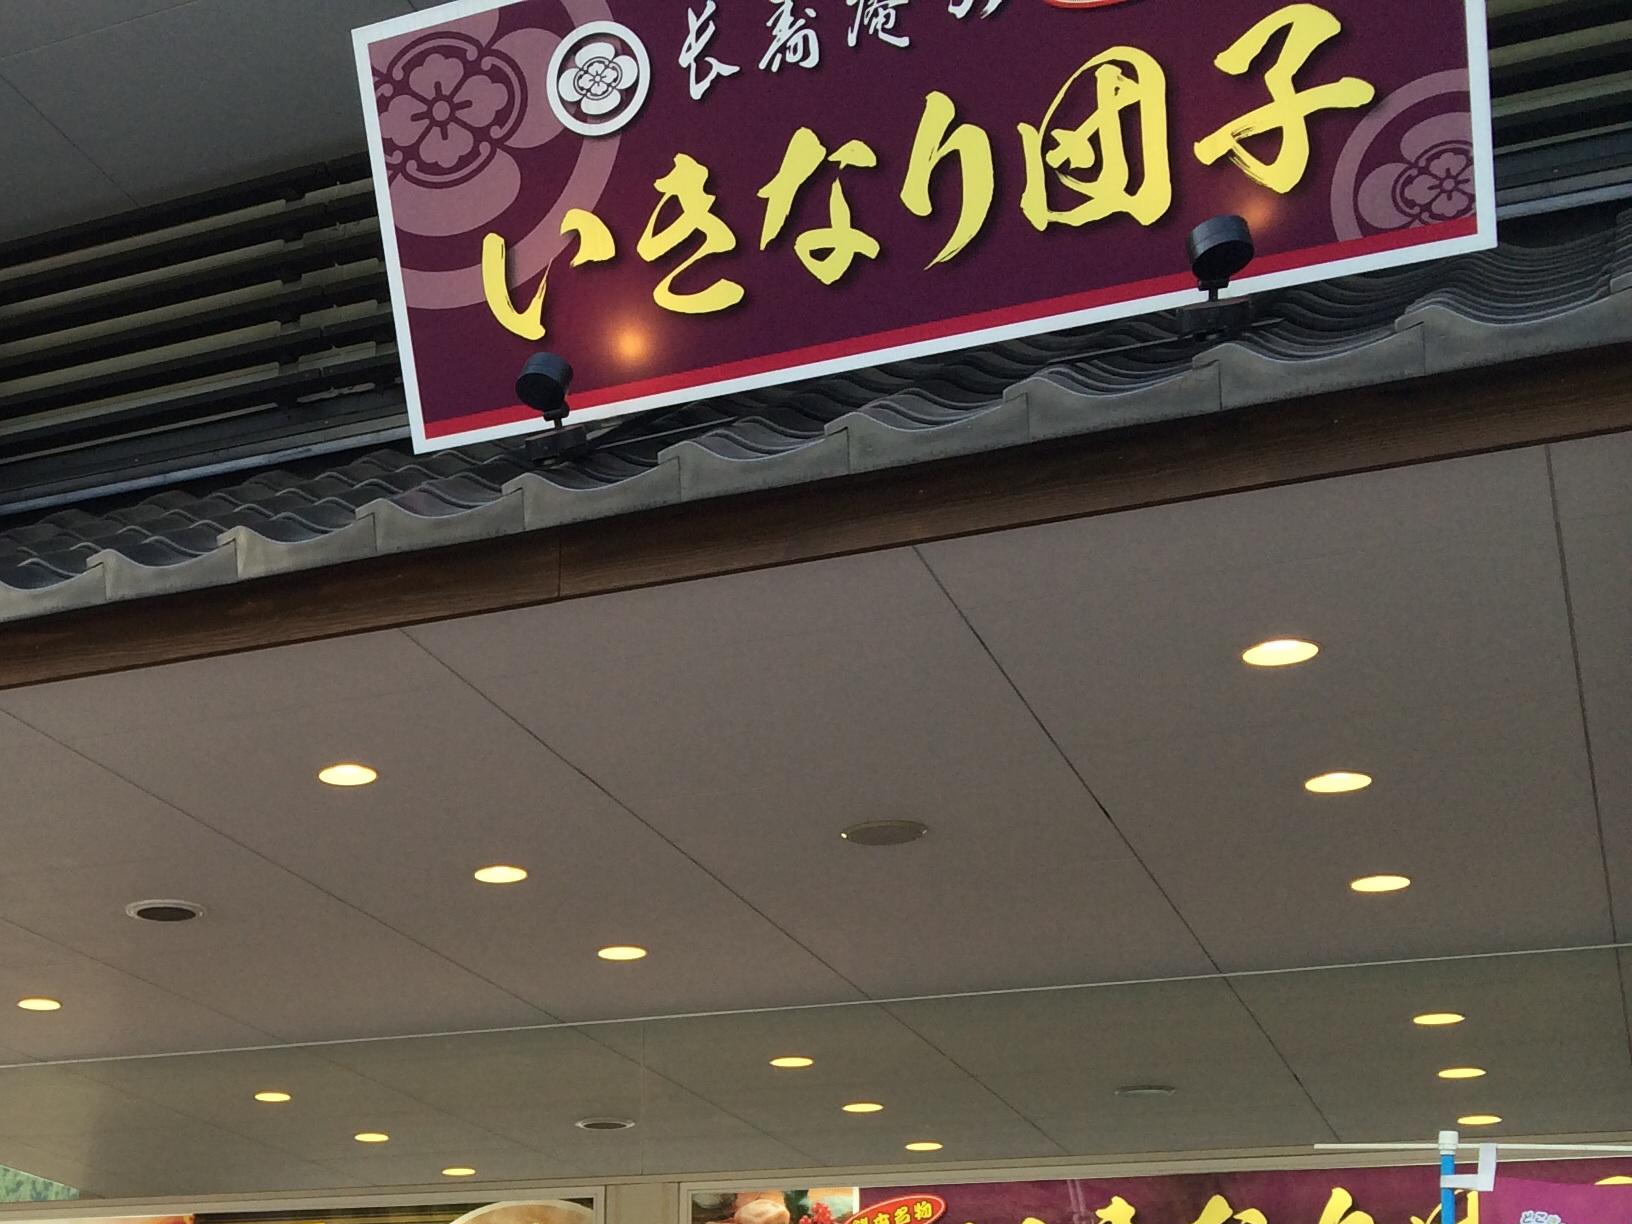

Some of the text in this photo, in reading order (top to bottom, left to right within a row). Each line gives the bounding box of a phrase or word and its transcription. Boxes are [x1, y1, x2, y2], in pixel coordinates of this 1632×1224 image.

[480, 3, 1376, 340] いきなり団子
